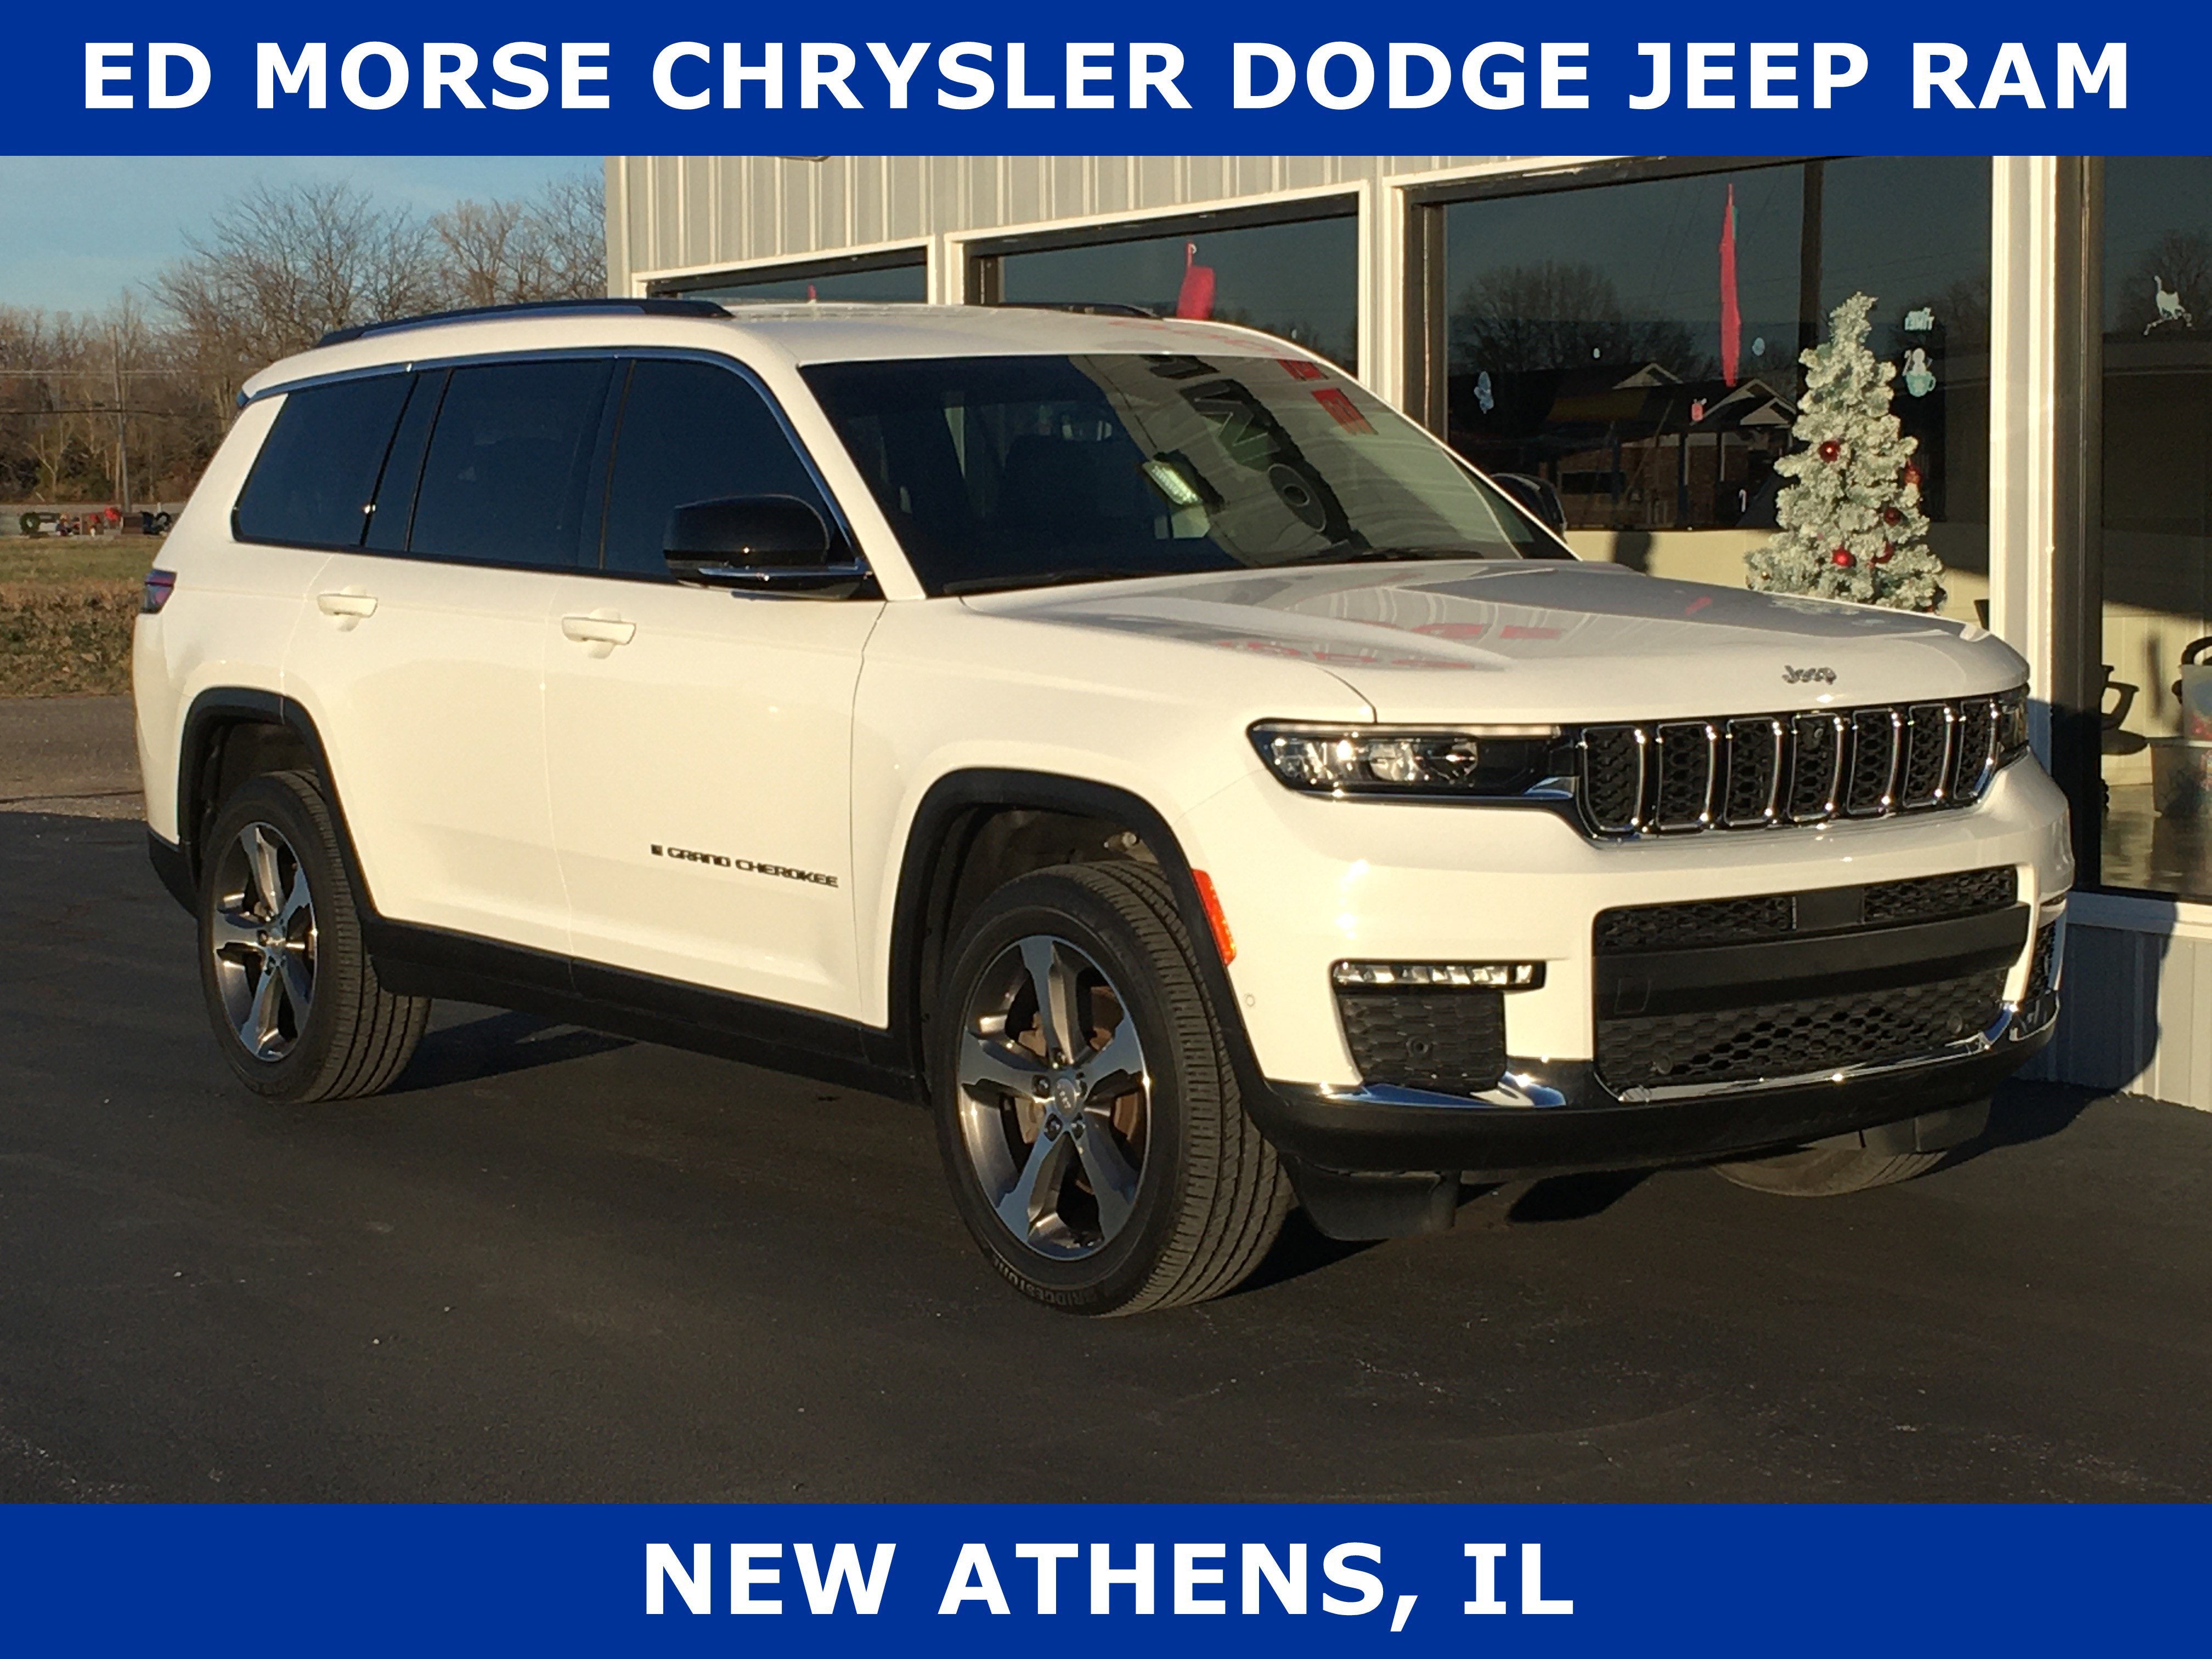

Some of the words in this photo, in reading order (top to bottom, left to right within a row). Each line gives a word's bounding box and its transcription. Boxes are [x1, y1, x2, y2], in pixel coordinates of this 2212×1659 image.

[1782, 665, 1837, 685] Jeep
[667, 846, 731, 867] GRAND
[735, 858, 839, 888] CHEROKEE
